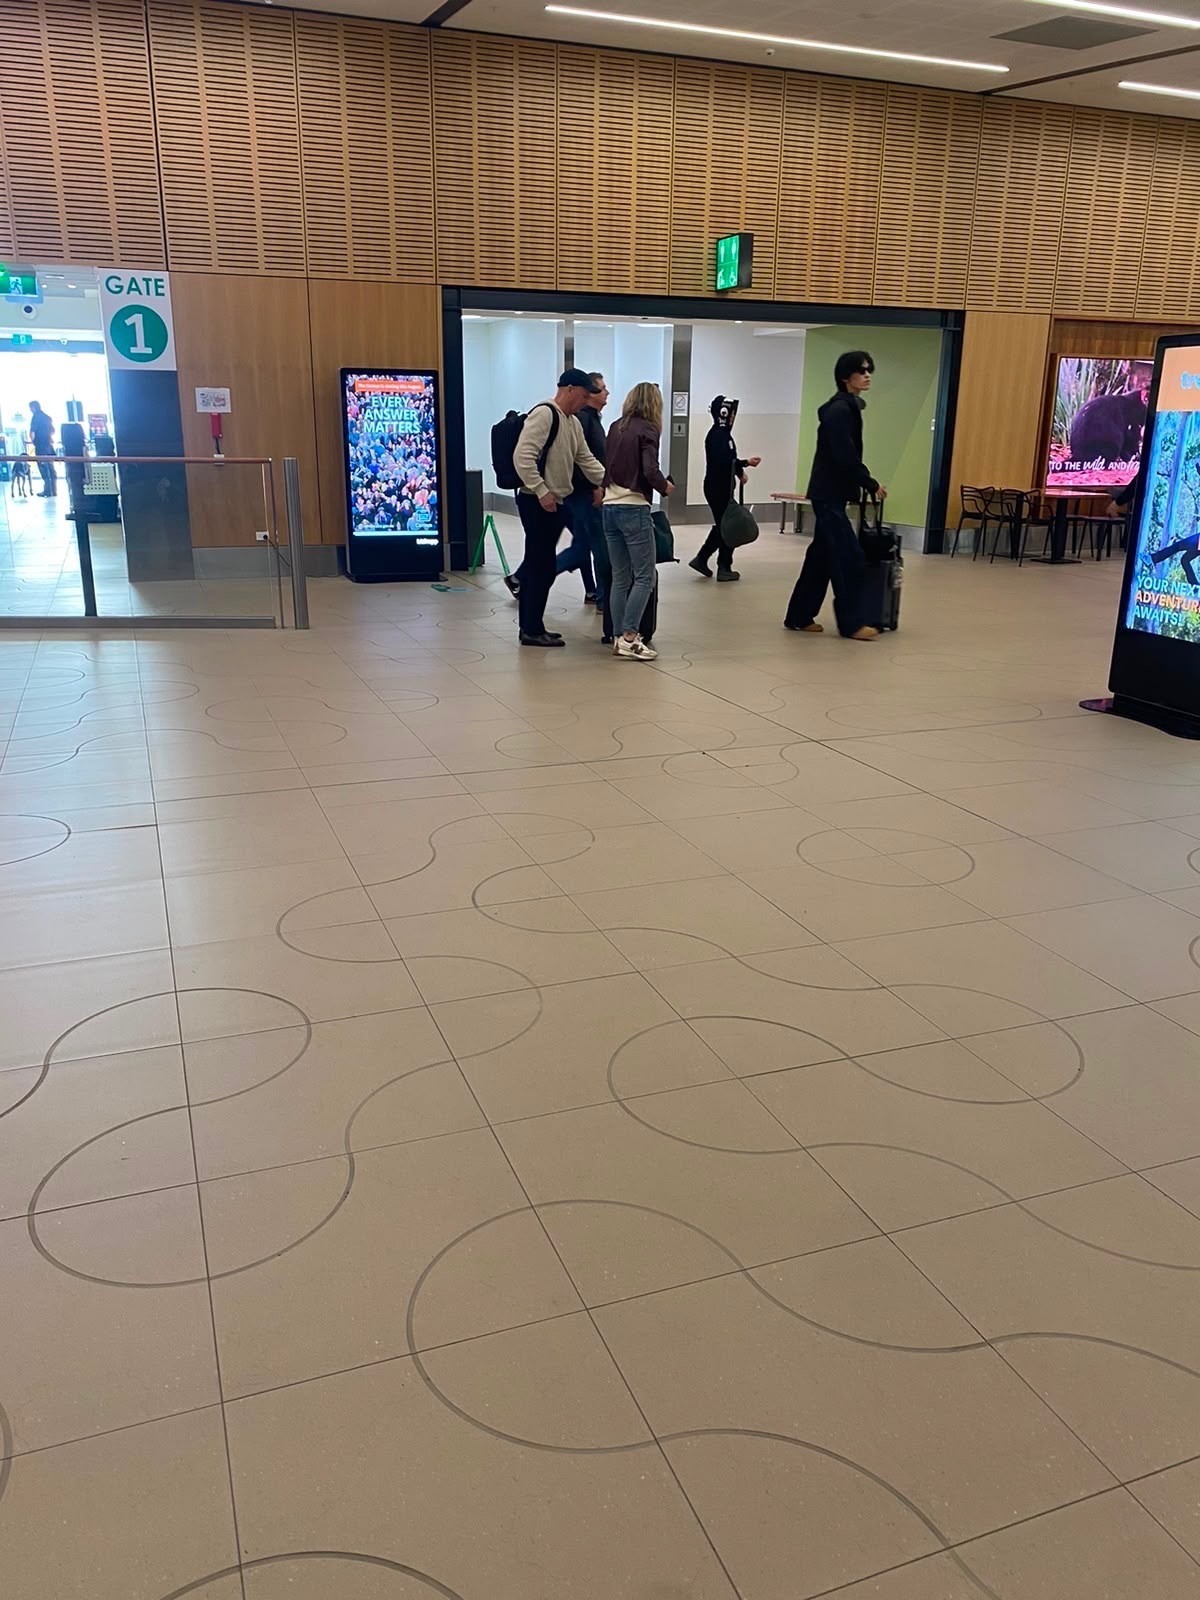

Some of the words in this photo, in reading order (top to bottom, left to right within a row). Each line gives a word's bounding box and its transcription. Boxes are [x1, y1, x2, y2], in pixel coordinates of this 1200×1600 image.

[105, 275, 166, 297] GATE
[124, 313, 153, 354] 1
[372, 396, 410, 408] EVERY
[364, 408, 419, 422] ANSWER
[363, 421, 421, 434] MATTERS
[1051, 461, 1063, 470] TO
[1064, 461, 1081, 470] THE
[1082, 455, 1106, 471] wild
[1108, 461, 1127, 470] AND
[1137, 576, 1169, 592] YOUR
[1135, 590, 1200, 612] ADVENTUR
[1133, 605, 1184, 627] AWAITS!
